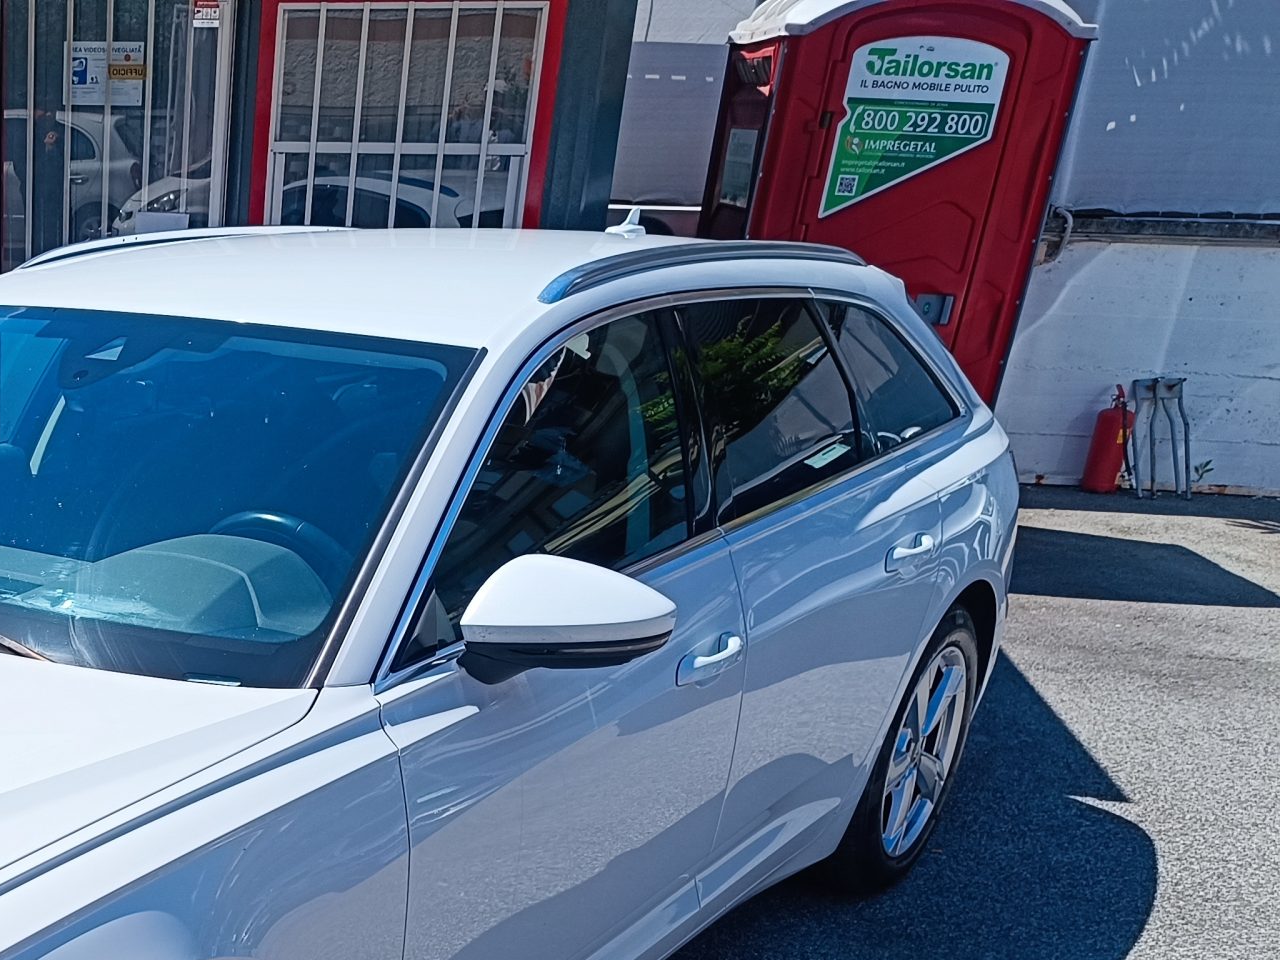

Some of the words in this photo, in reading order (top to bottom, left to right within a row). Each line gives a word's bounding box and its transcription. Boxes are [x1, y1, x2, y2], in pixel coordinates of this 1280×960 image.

[865, 47, 994, 81] Tailorsan
[860, 79, 869, 88] IL
[871, 80, 909, 91] BAGNO
[912, 82, 951, 92] MOBILE
[953, 84, 989, 93] PULITO
[861, 110, 899, 131] 800
[903, 112, 941, 133] 292
[945, 114, 983, 135] 800
[864, 139, 936, 153] IMPREGETAL
